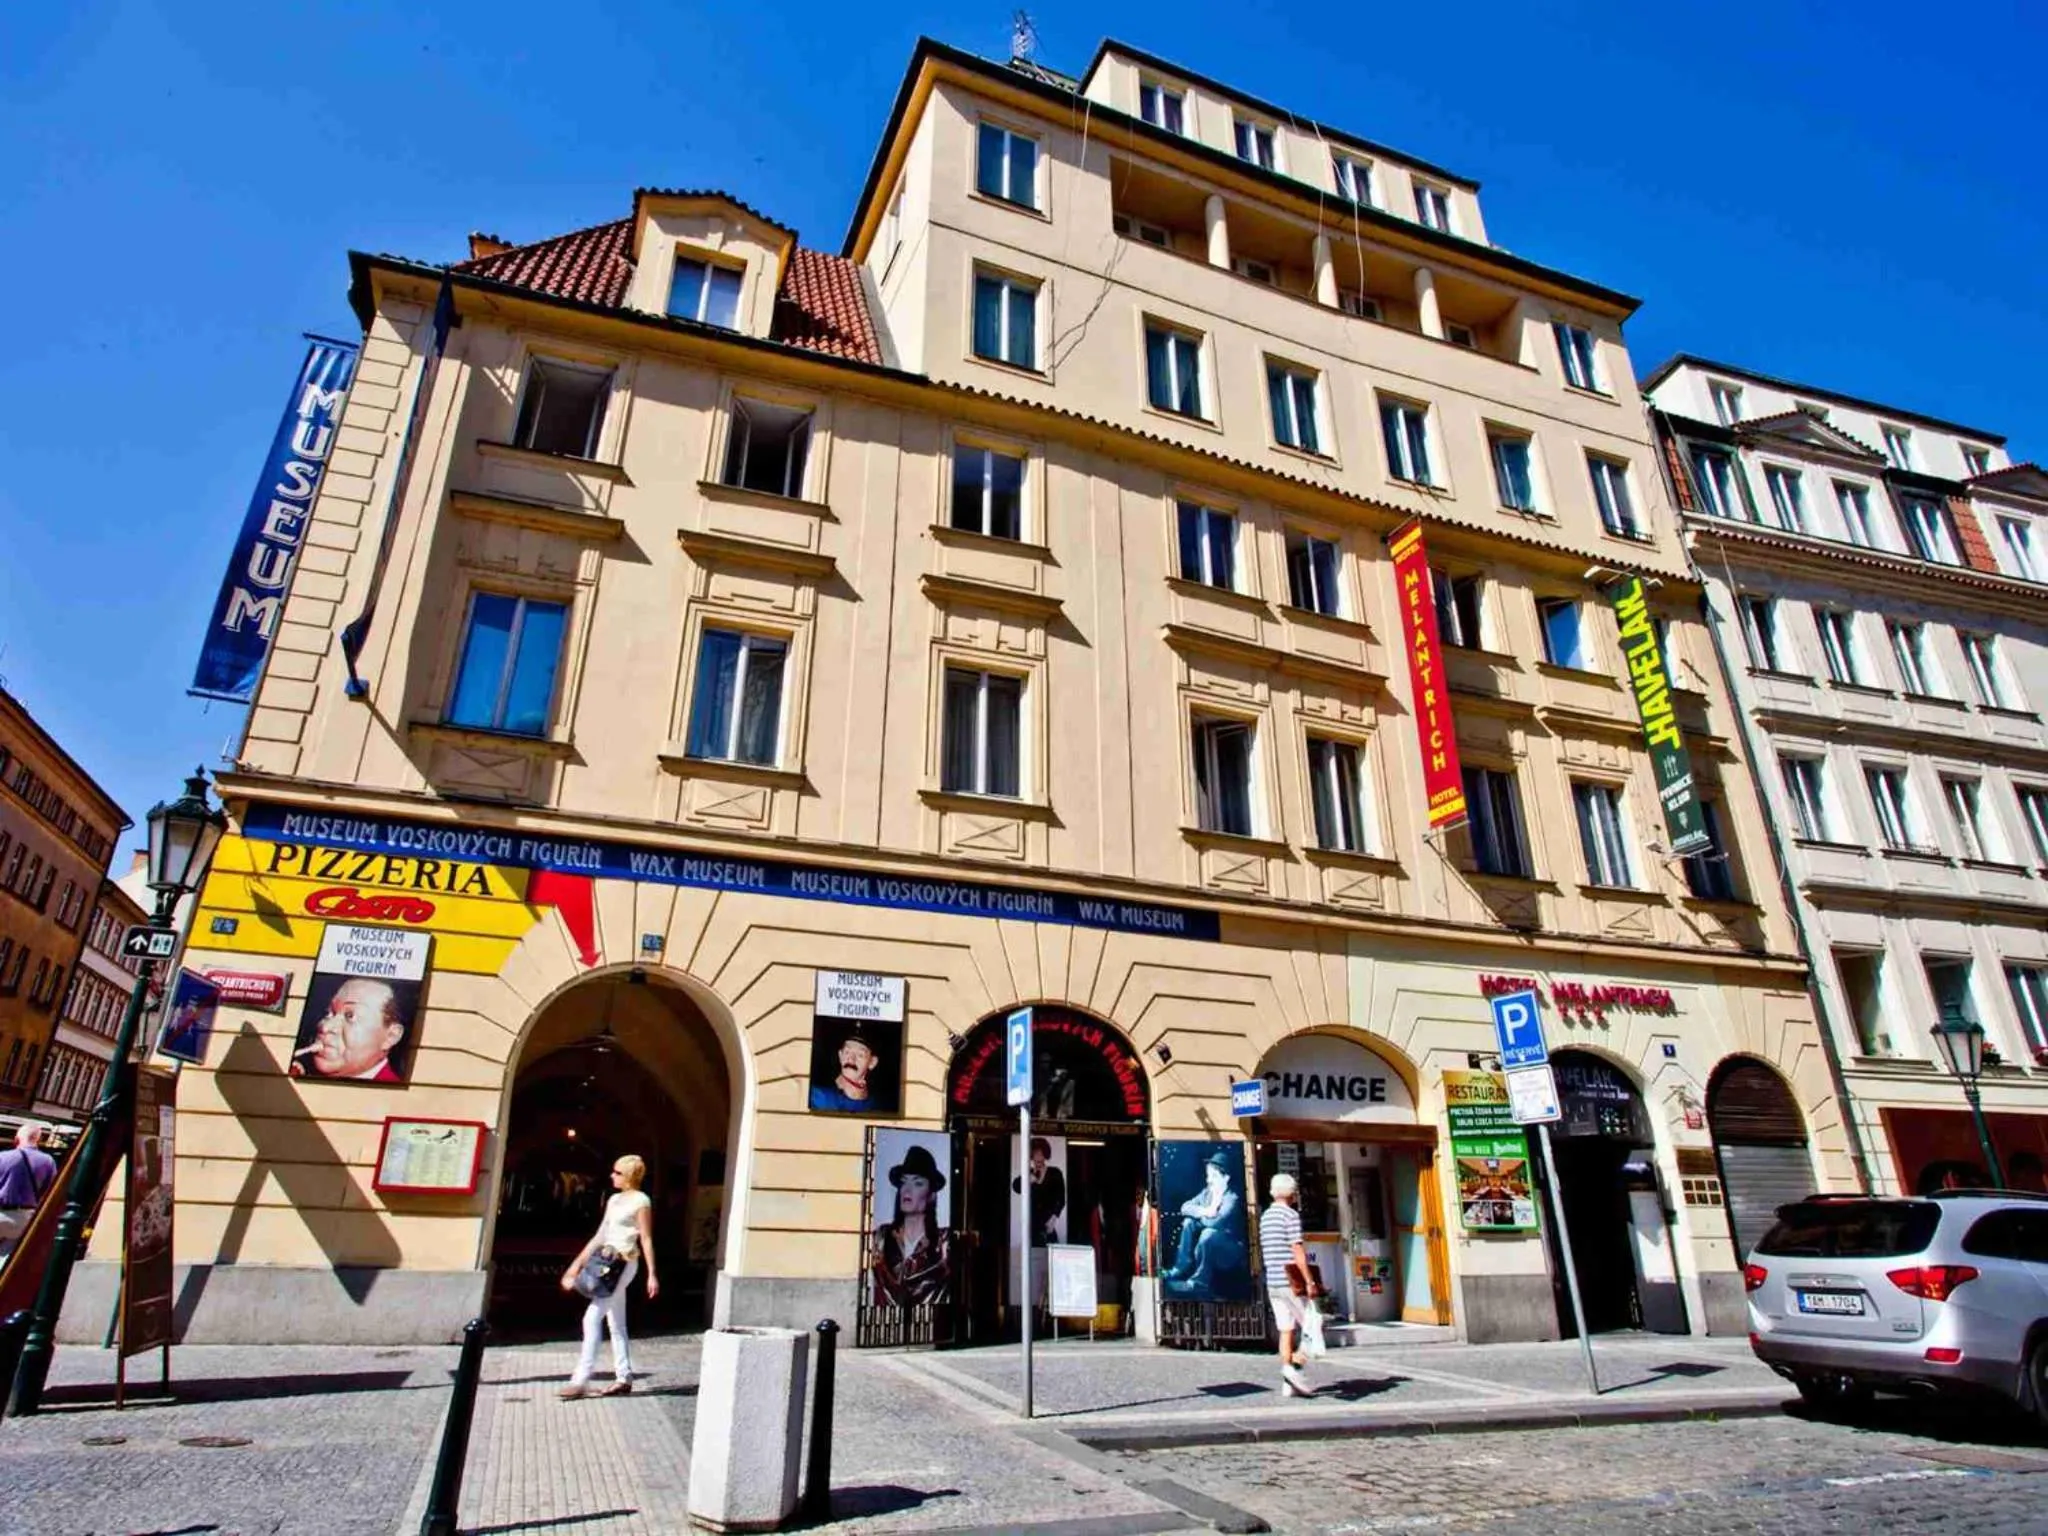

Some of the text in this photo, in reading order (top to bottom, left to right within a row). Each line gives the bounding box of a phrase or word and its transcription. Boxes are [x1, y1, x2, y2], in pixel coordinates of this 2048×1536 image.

[222, 383, 348, 640] MUSEUM
[1396, 543, 1420, 564] HOTEL
[1405, 569, 1447, 772] MELANTRICH
[1431, 787, 1459, 806] HOTEL
[281, 812, 603, 869] MUSEUM VOSKOVÝCH FIGURÍN
[267, 842, 493, 896] PIZZERIA
[630, 852, 765, 887] WAX MUSEUM
[790, 870, 1054, 916] MUSEUM VOSKOVÝCH FIGURÍN
[1078, 900, 1184, 931] WAX MUSEUM
[350, 927, 405, 943] MUSEUM
[837, 972, 883, 987] MUSEUM
[1502, 1003, 1528, 1045] P
[1011, 1023, 1025, 1075] P
[1232, 1088, 1262, 1108] CHANGE
[1264, 1072, 1386, 1102] CHANGE
[1448, 1084, 1509, 1101] RESTAURAN
[1831, 1296, 1858, 1309] 1704
